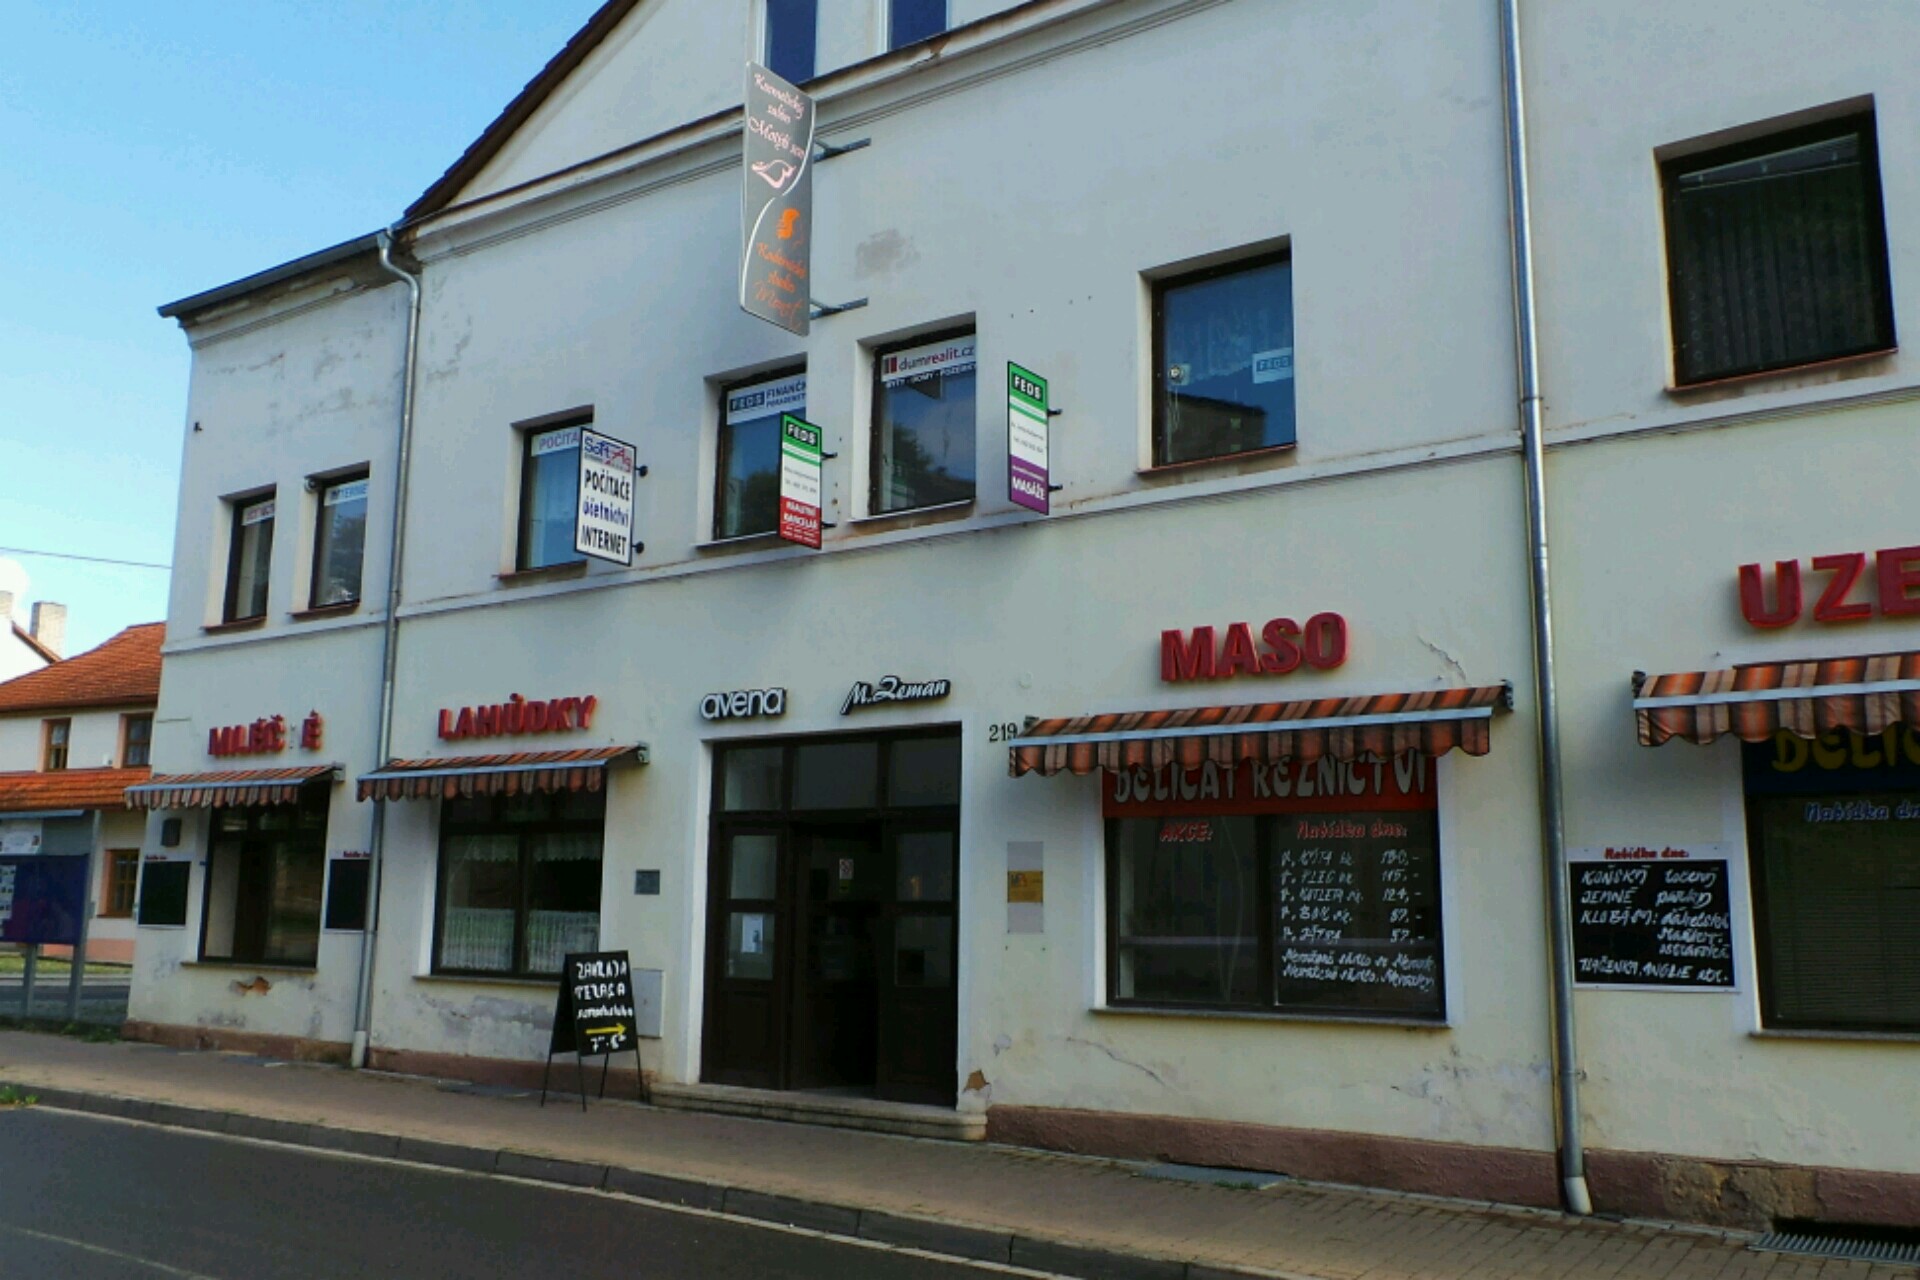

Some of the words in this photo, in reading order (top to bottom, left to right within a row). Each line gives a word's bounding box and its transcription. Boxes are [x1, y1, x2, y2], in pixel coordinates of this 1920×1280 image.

[1014, 374, 1042, 400] FEDS
[787, 424, 817, 446] FEDS
[584, 467, 631, 502] POČÍTAČE
[581, 524, 628, 557] INTERNET
[1160, 611, 1350, 683] MASO
[701, 687, 784, 720] avena
[437, 692, 598, 740] LAHŮDKY
[989, 722, 1018, 742] 219
[1805, 801, 1889, 823] Nabídka
[1296, 819, 1366, 841] Nabídka
[1580, 886, 1638, 904] JEMNÉ
[574, 982, 626, 1000] TERASA
